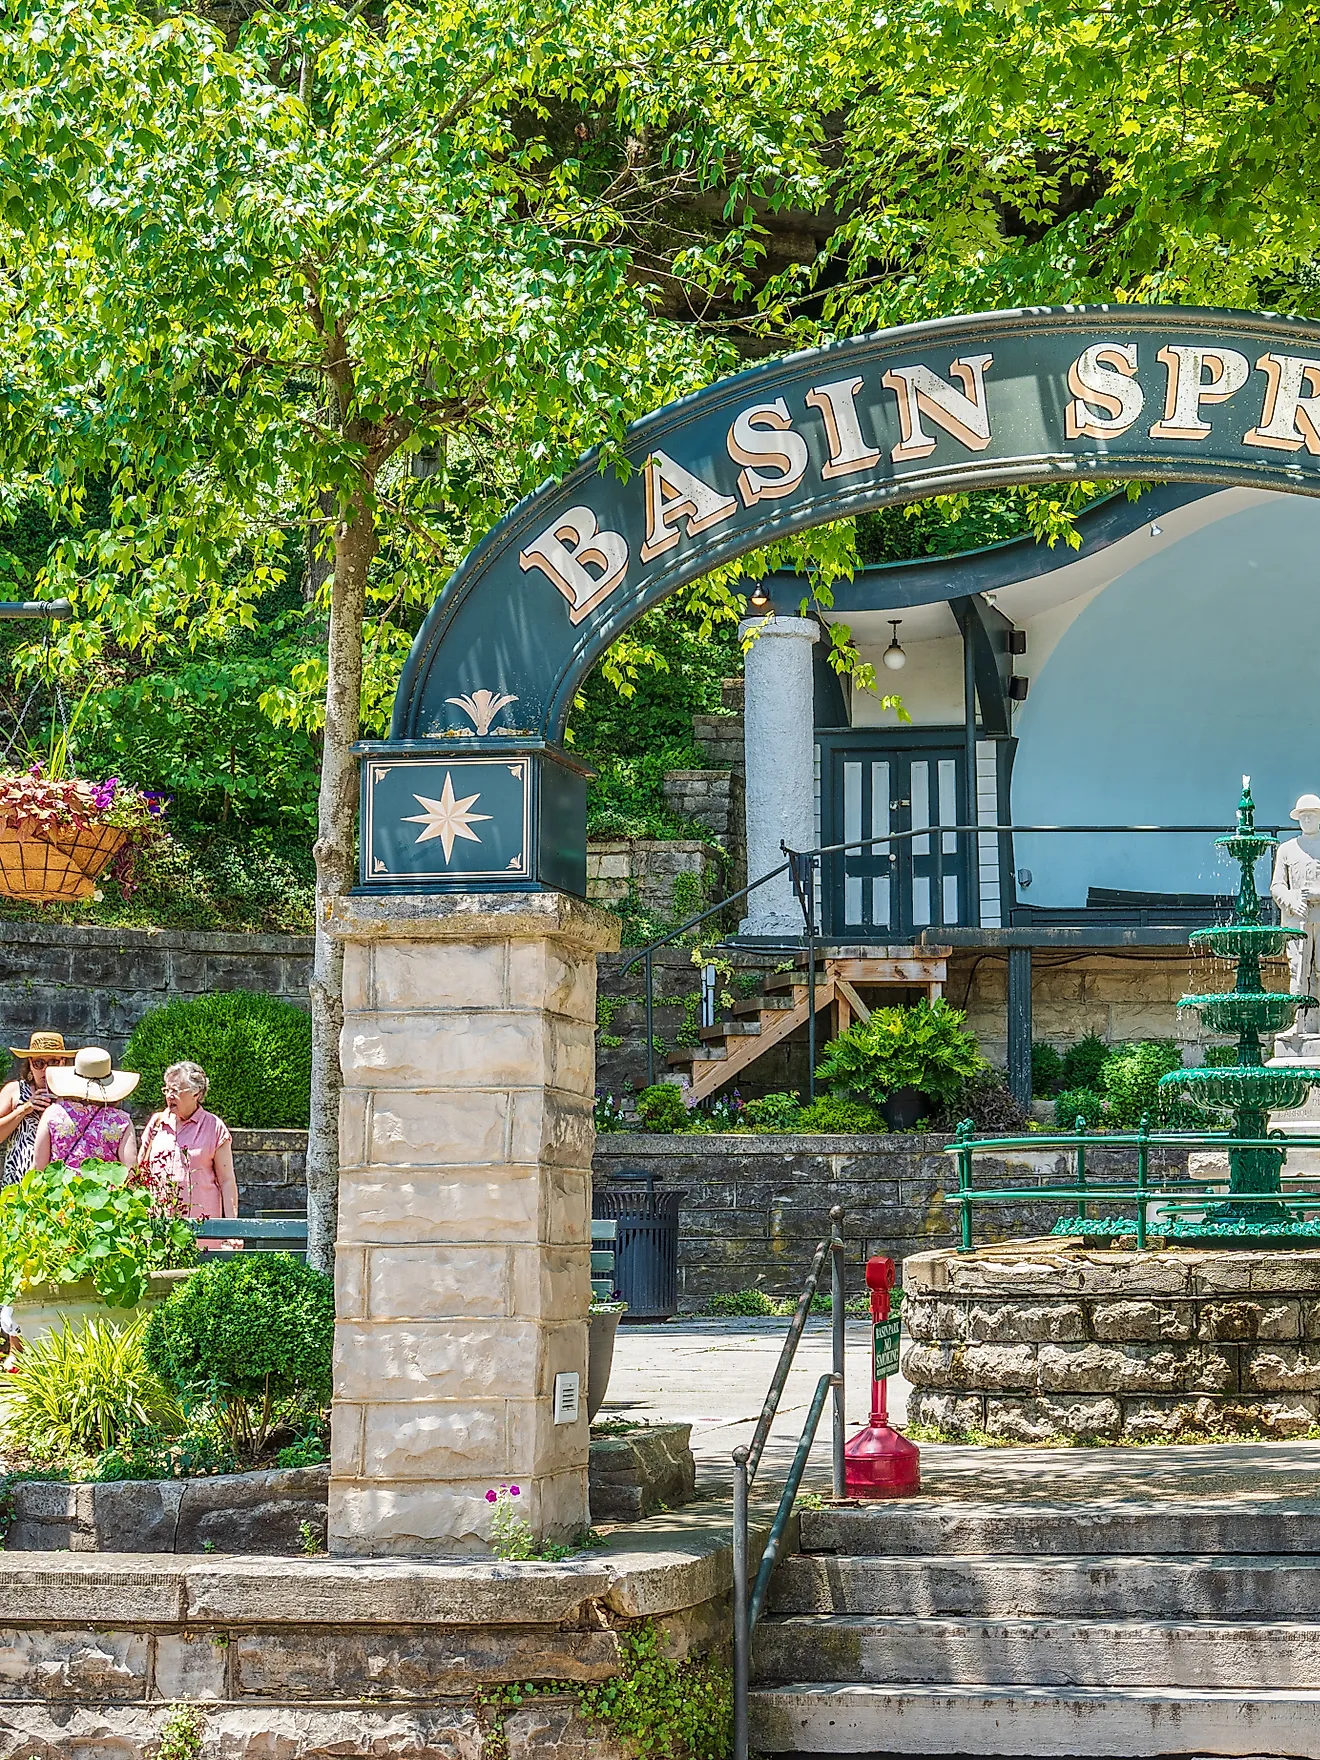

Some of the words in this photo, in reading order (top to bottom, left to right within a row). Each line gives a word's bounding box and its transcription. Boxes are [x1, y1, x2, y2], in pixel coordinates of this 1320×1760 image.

[519, 352, 995, 626] BASIN
[884, 1337, 892, 1351] NO
[876, 1348, 899, 1368] SMOKING
